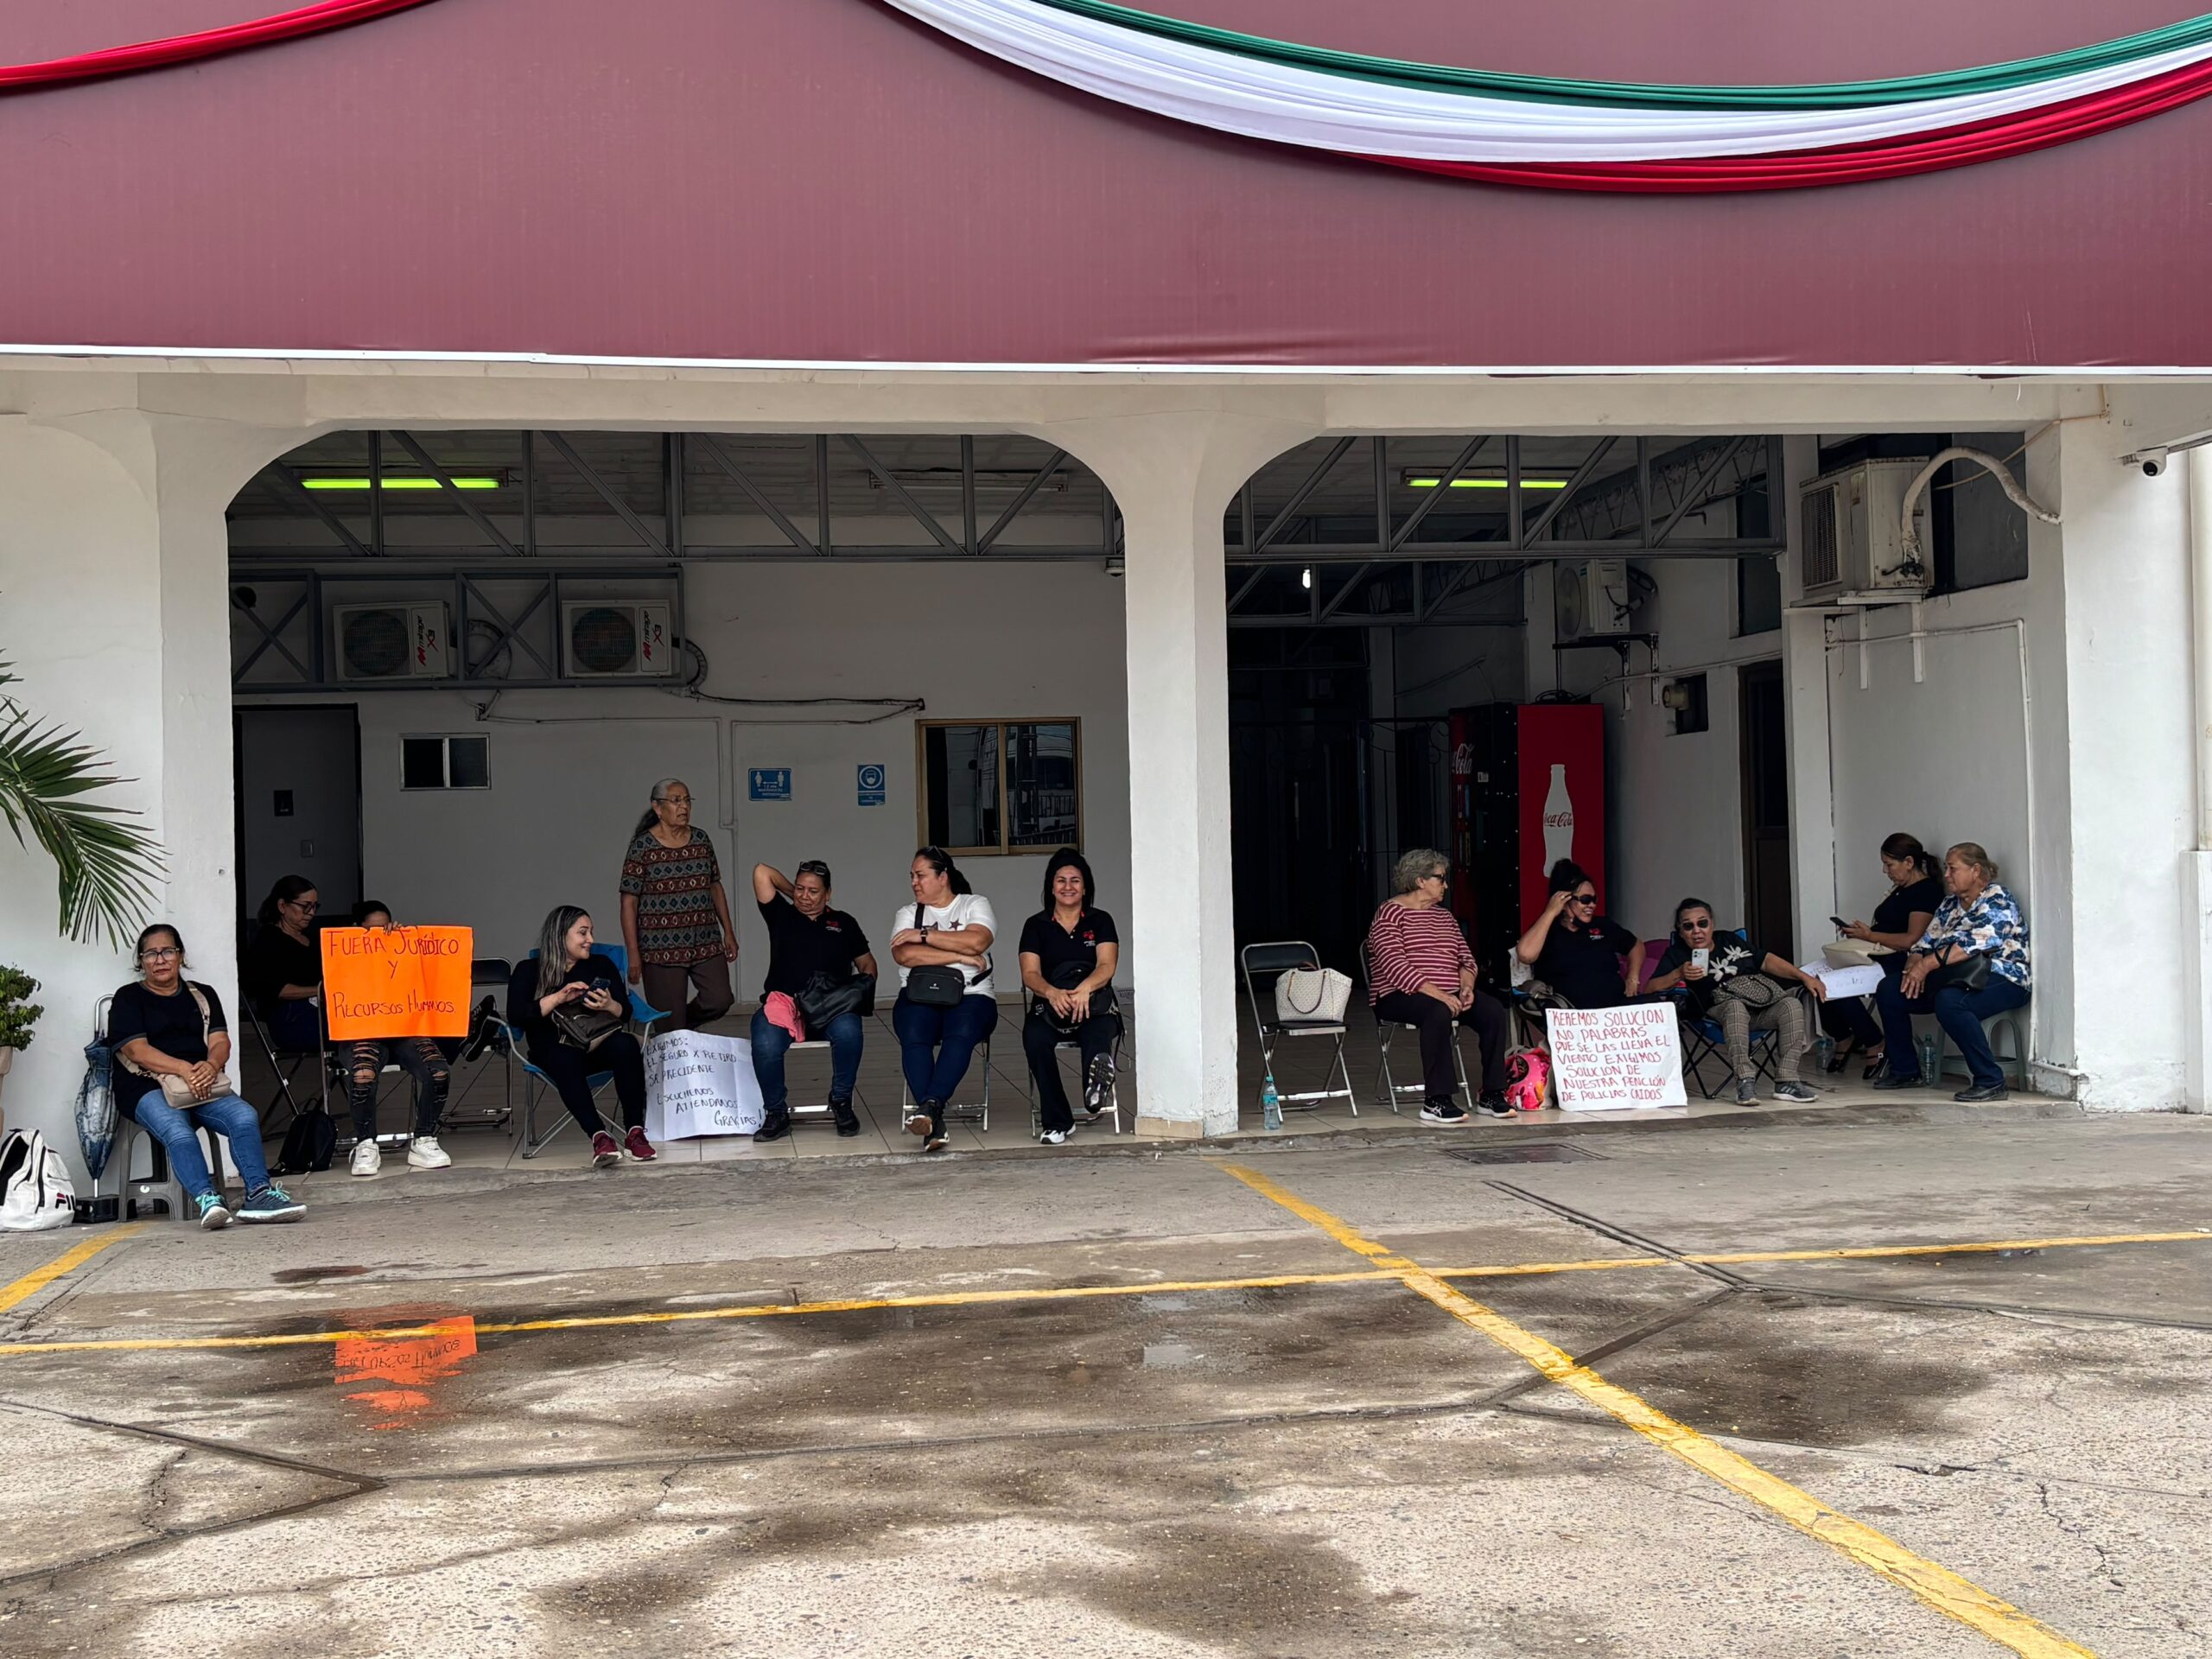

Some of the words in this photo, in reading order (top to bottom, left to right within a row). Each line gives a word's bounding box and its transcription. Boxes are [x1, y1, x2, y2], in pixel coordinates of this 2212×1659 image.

[327, 931, 386, 957] FUERA
[388, 960, 397, 979] Y
[333, 992, 404, 1018] RECURSOS
[1605, 1009, 1664, 1027] SOLUCION
[1556, 1029, 1573, 1040] NO
[1580, 1027, 1647, 1042] PALABRAS
[1556, 1041, 1575, 1053] QUE
[1577, 1042, 1592, 1053] SE
[1596, 1042, 1618, 1053] LAS
[1656, 1034, 1670, 1047] EL
[659, 1049, 689, 1062] SEGURO
[693, 1049, 700, 1058] X
[1558, 1053, 1598, 1065] VIENTO
[1605, 1052, 1661, 1065] EXIGIMOS
[1566, 1065, 1622, 1078] SOLUCION
[1626, 1065, 1641, 1076] DE
[1563, 1077, 1618, 1090] NUESTRA
[1561, 1091, 1576, 1102] DE
